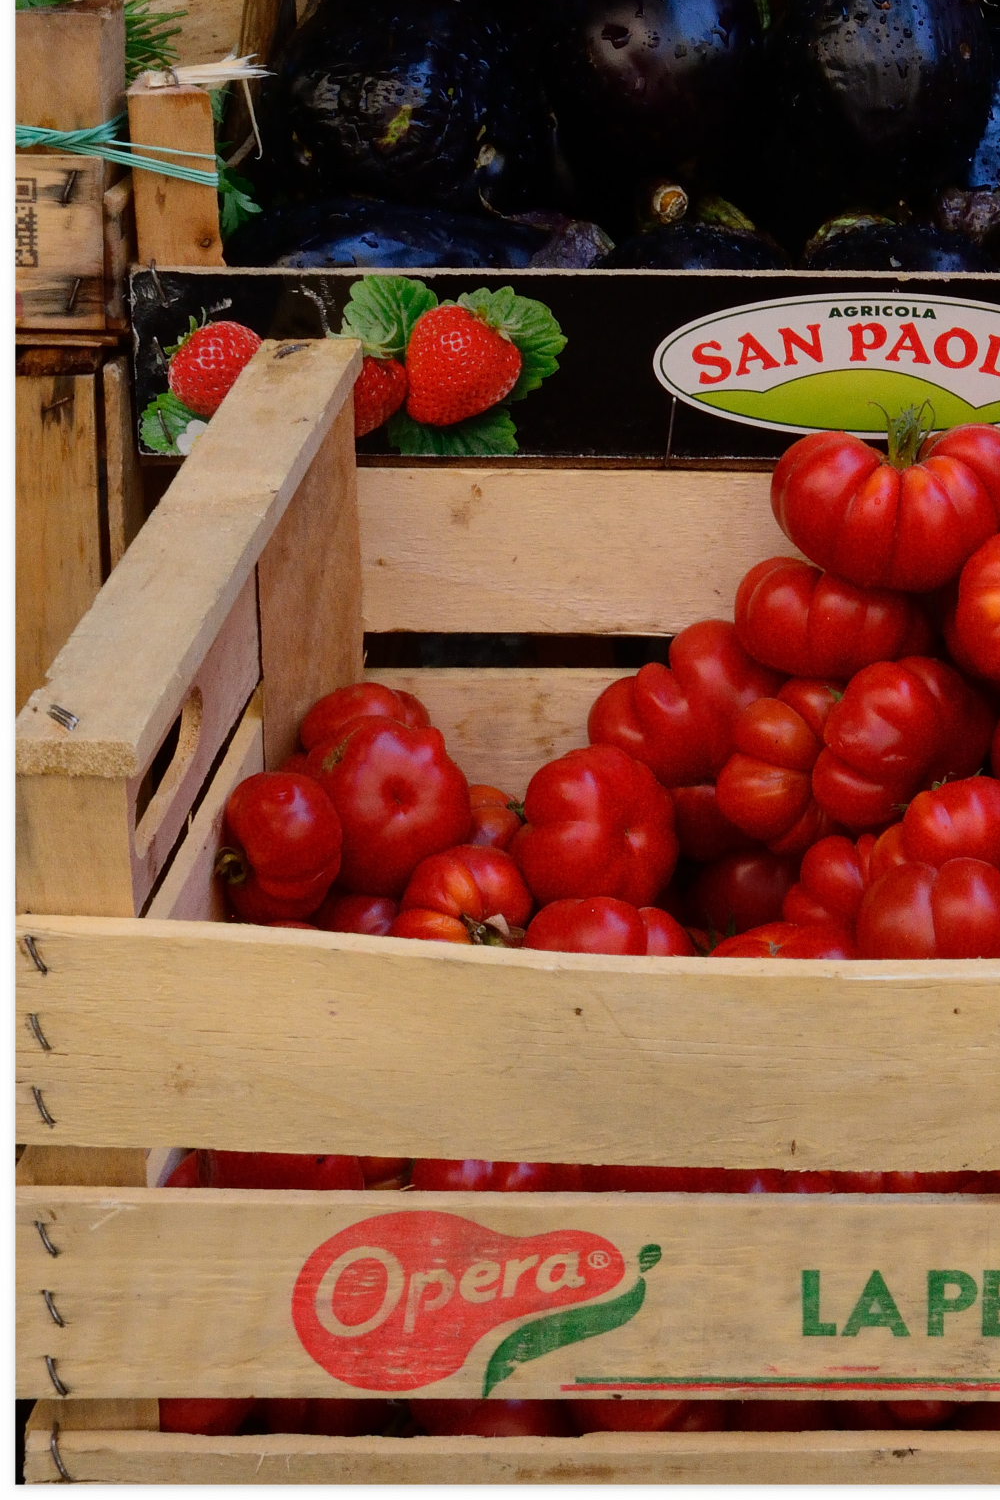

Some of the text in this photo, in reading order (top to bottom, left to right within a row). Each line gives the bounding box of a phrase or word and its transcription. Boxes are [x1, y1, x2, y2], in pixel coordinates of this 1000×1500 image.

[828, 306, 937, 320] AGRICOLA
[691, 323, 824, 385] SAN
[314, 1244, 586, 1337] Opera
[801, 1269, 911, 1337] LA
